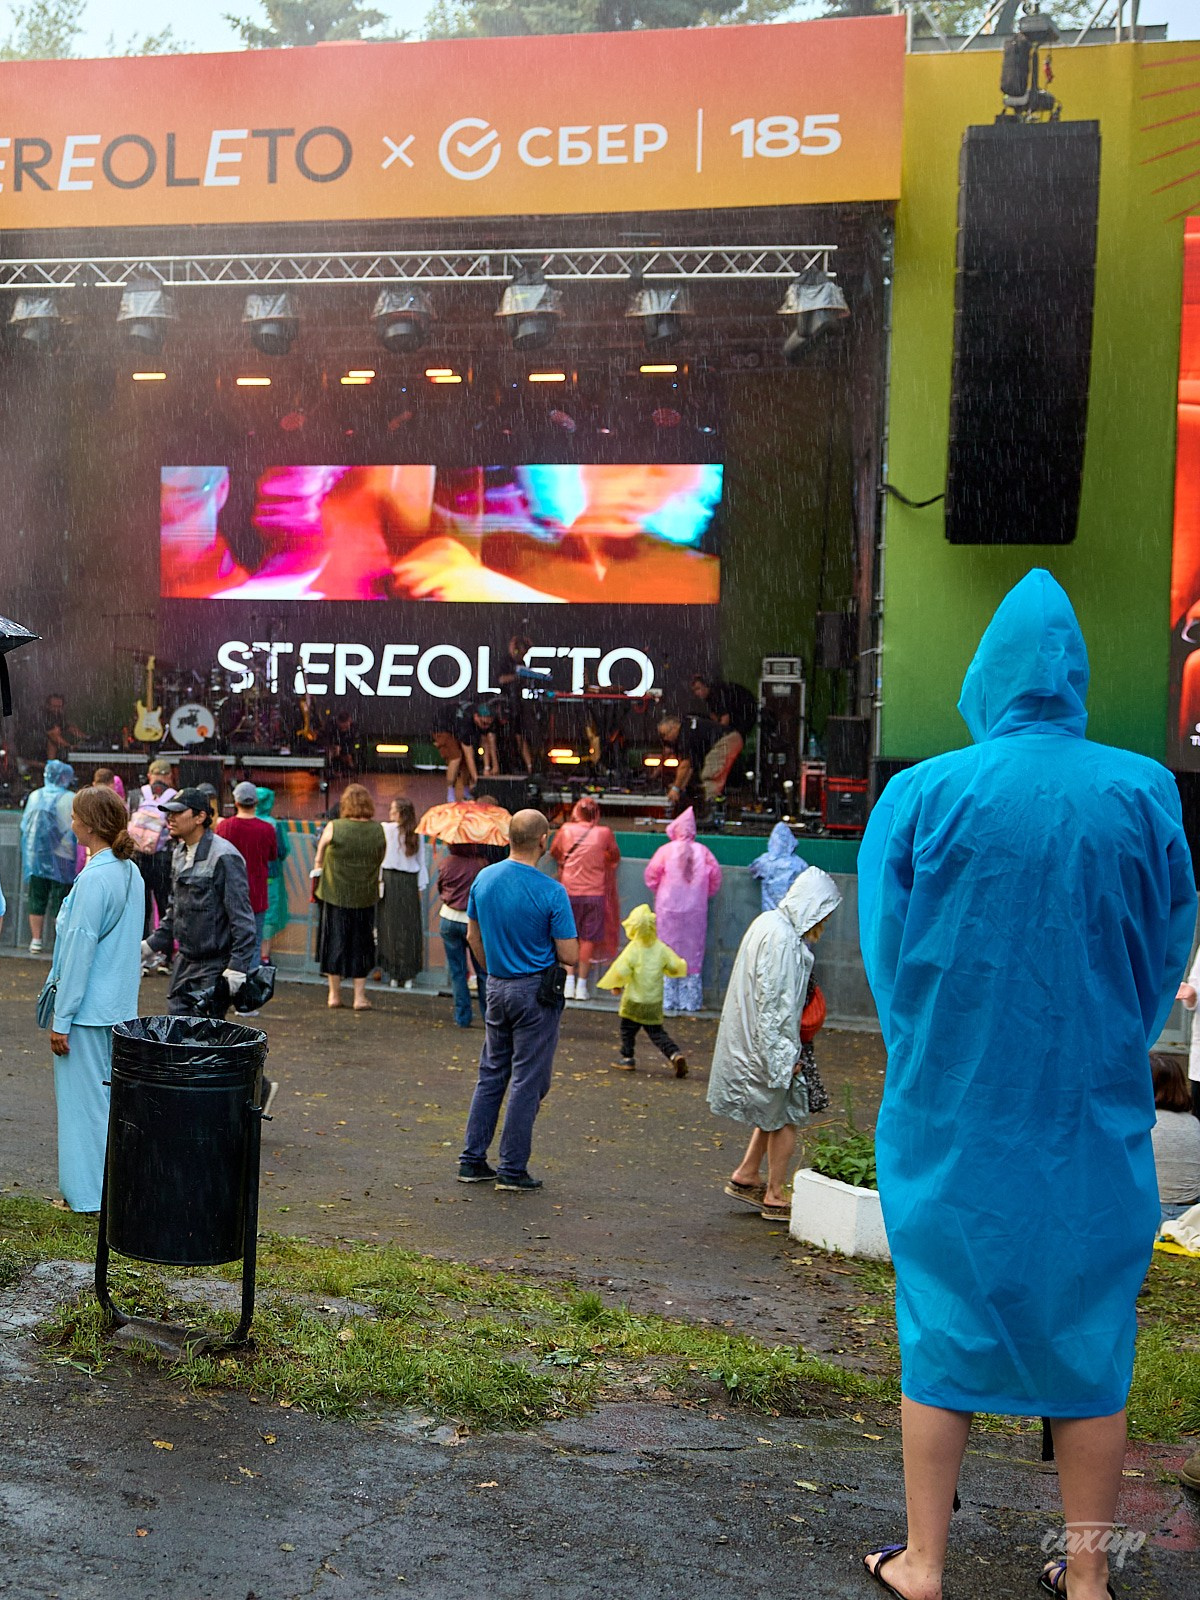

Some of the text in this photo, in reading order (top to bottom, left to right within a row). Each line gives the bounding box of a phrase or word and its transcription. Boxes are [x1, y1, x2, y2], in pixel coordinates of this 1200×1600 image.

[517, 113, 843, 168] СБЕР 185
[217, 640, 656, 699] STEREOLETO
